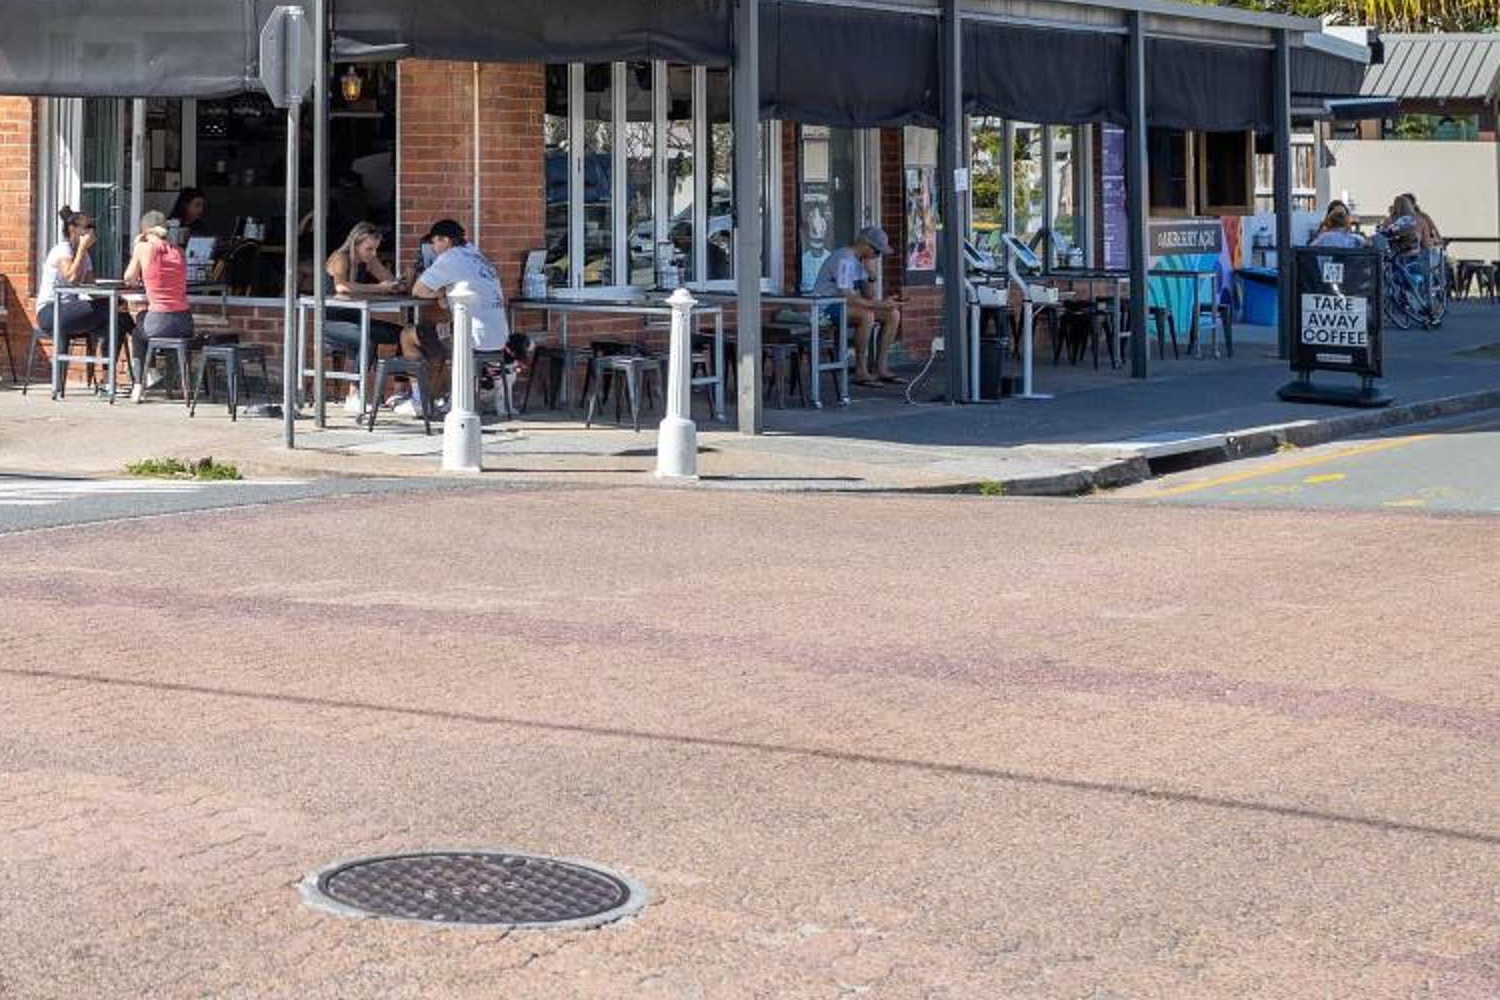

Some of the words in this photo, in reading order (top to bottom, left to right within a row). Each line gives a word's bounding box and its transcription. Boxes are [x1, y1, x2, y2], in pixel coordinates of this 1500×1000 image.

[1313, 296, 1354, 311] TAKE
[1308, 313, 1359, 329] AWAY
[1303, 329, 1366, 345] COFFEE
